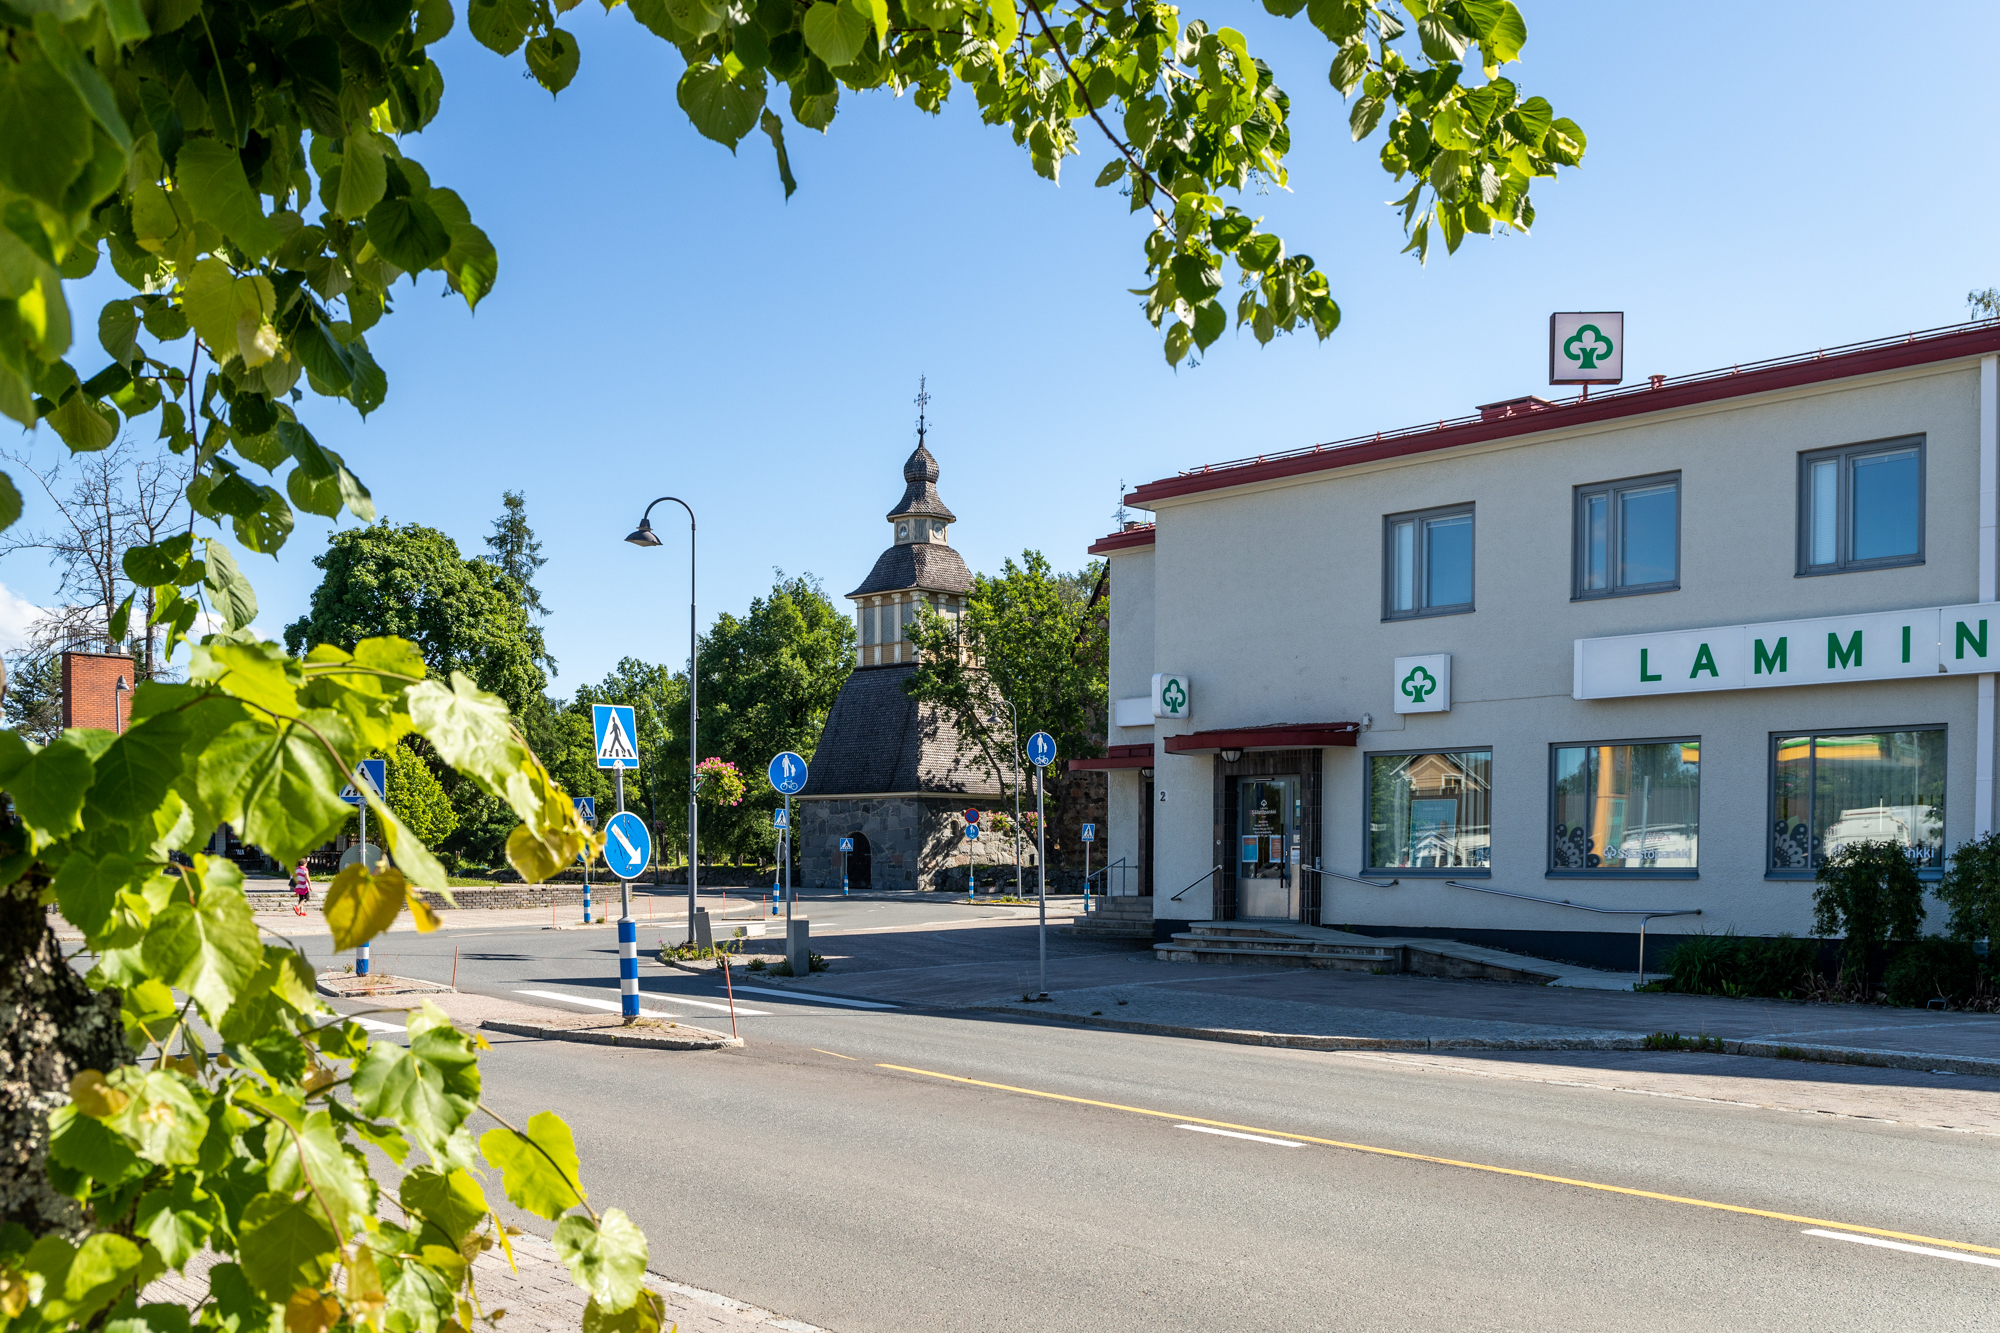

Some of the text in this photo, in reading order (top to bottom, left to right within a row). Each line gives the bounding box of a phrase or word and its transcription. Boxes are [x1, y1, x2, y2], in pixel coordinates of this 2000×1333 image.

[1640, 619, 1988, 682] LAMMIN
[1160, 791, 1166, 801] 2
[1618, 848, 1691, 860] Säästöpankki
